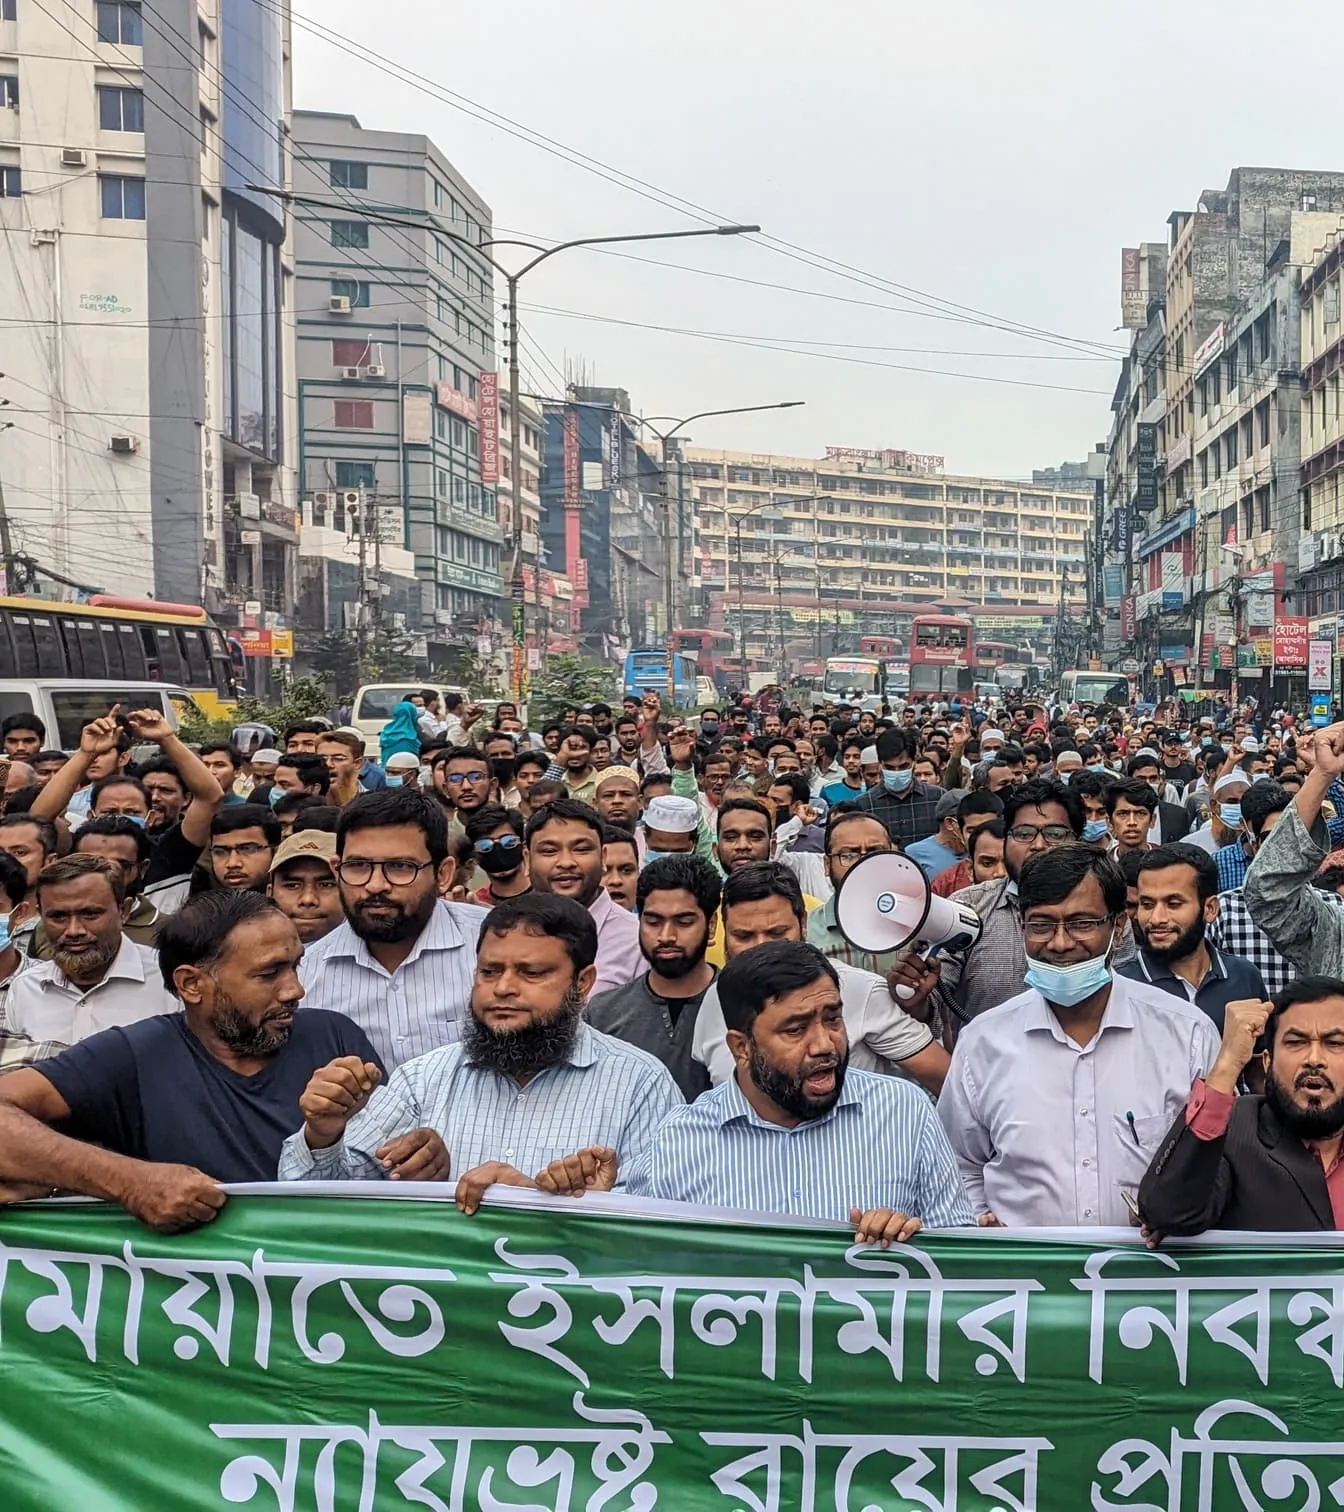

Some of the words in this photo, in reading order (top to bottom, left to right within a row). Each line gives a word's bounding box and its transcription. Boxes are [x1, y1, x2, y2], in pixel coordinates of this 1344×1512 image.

[1126, 595, 1136, 641] KONKA
[1275, 622, 1307, 637] হোটেল
[0, 1240, 457, 1370] মায়াতে
[488, 1237, 1046, 1388] ইসলামীর
